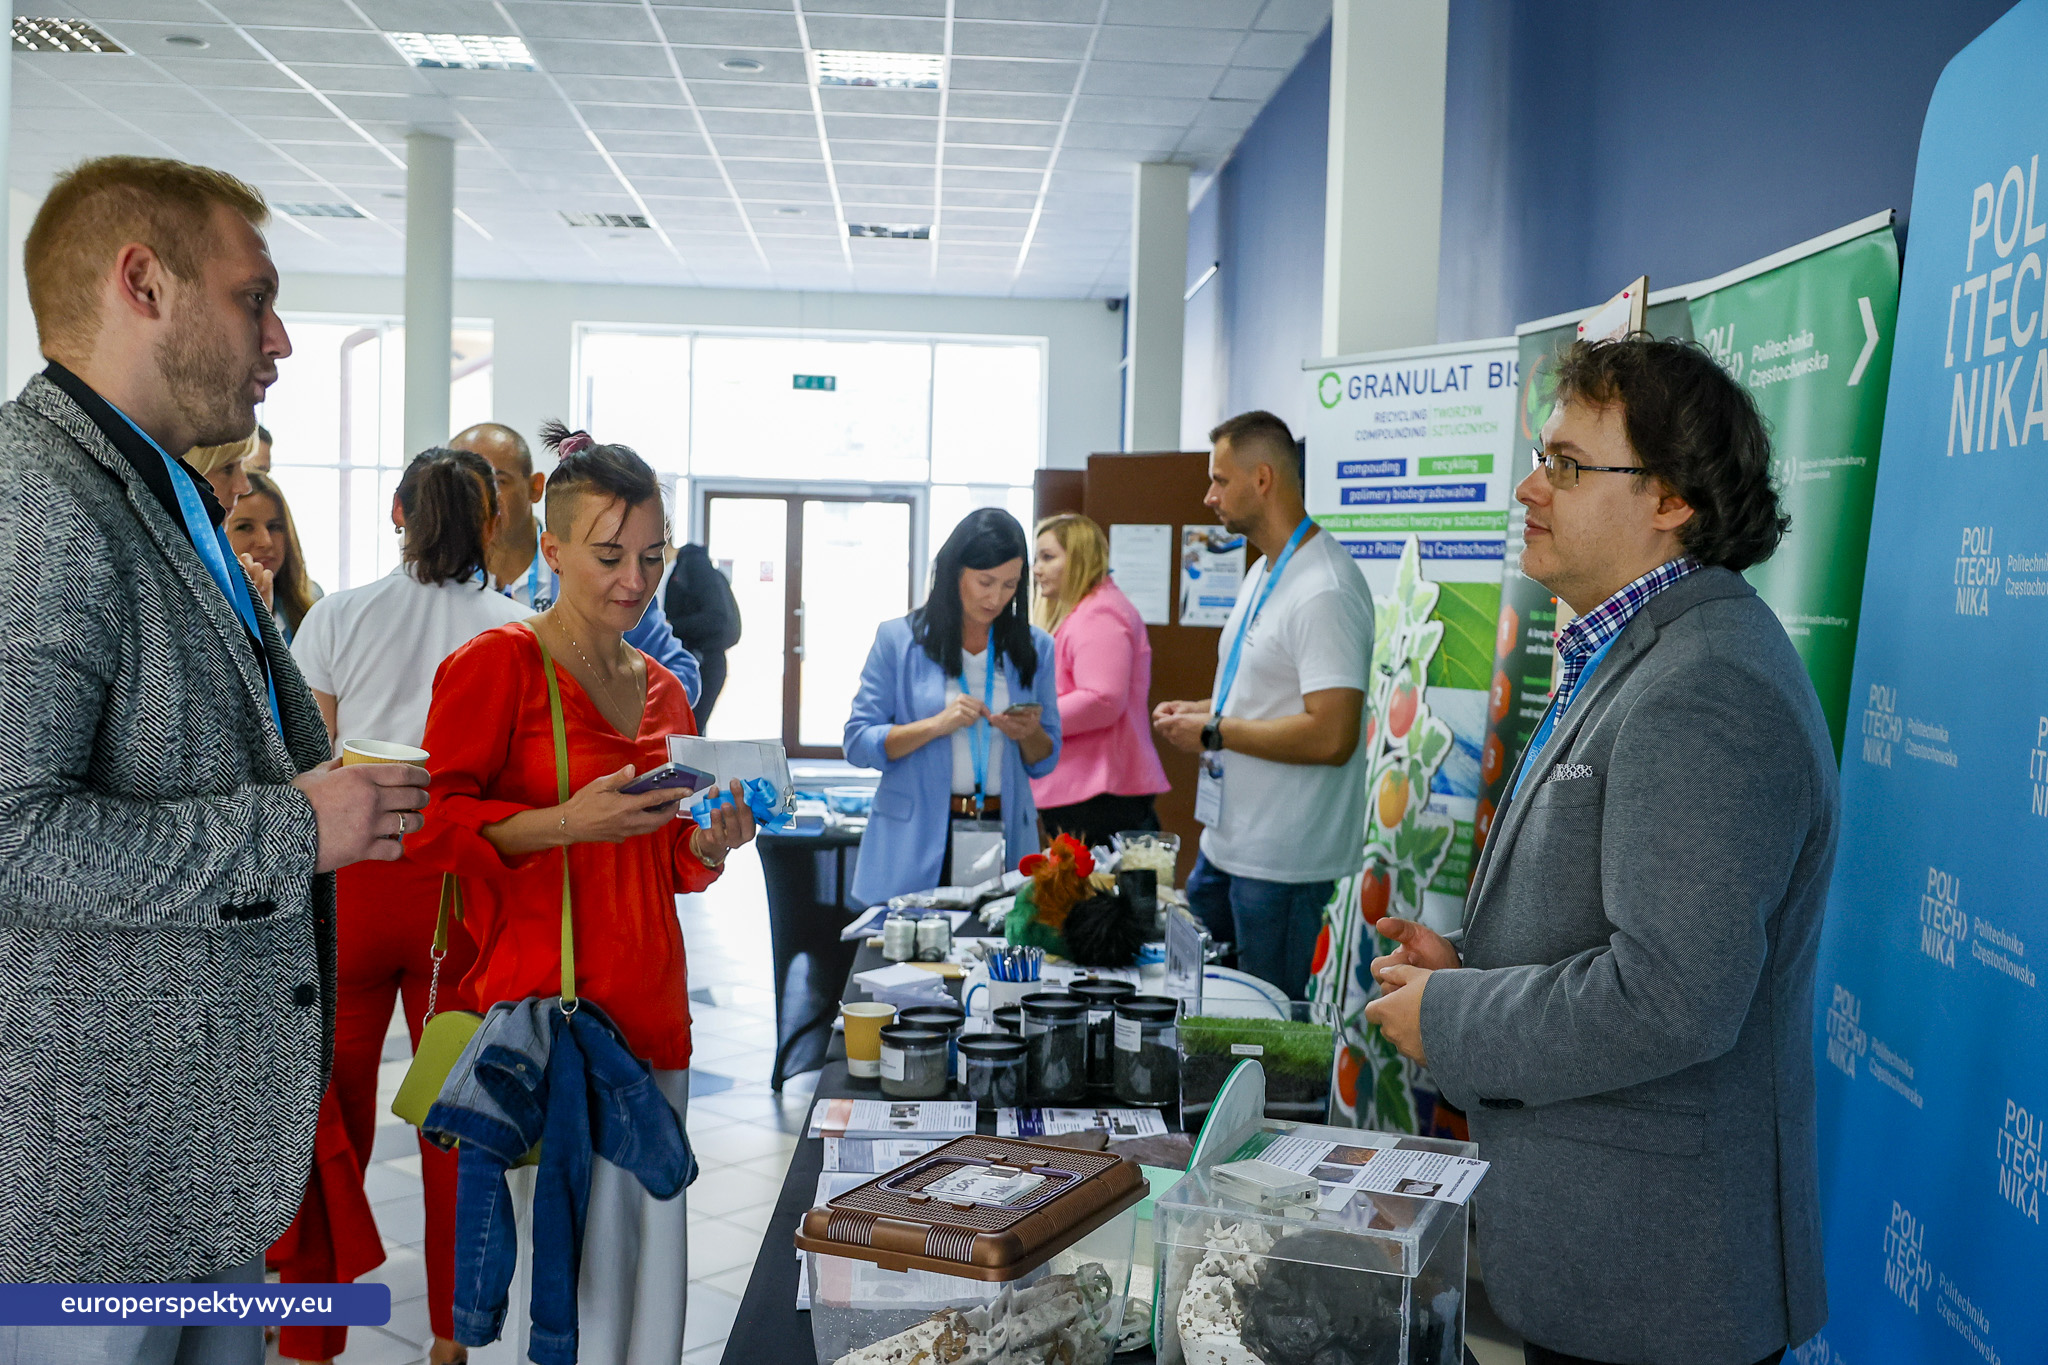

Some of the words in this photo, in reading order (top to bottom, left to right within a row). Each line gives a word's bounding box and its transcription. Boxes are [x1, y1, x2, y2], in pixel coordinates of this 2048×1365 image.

[1751, 329, 1815, 364] Politechnika
[1348, 364, 1473, 401] GRANULAT
[1749, 350, 1829, 389] Częstochowska
[1374, 407, 1427, 424] RECYCLING
[1433, 405, 1483, 418] TWORZYW
[1947, 348, 2048, 457] NIKA
[1355, 425, 1427, 441] COMPOUNDING
[1432, 421, 1498, 437] SZTUCZNYCH
[1432, 456, 1479, 473] recykling
[1349, 489, 1391, 504] polimery
[1393, 485, 1477, 502] biodegradowalne
[1411, 515, 1452, 530] tworzyw
[1961, 526, 1994, 556] POLI
[1955, 586, 1988, 616] NIKA
[1503, 620, 1509, 641] 1
[1494, 686, 1503, 706] 2
[1868, 683, 1897, 713] POLI
[1907, 716, 1949, 743] Politechnika
[1862, 736, 1892, 769] NIKA
[1927, 866, 1960, 907] POLI
[1921, 924, 1955, 969] NIKA
[1974, 916, 2024, 957] Politechnika
[1972, 939, 2036, 988] Częstochowska
[1832, 983, 1861, 1026] POLI
[1826, 1035, 1856, 1080] NIKA
[2005, 1098, 2044, 1153] POLI
[1998, 1163, 2039, 1225] NIKA
[1891, 1200, 1925, 1253] POLI
[1884, 1257, 1919, 1315] NIKA
[1939, 1271, 1990, 1335] Politechnika
[1936, 1293, 2001, 1365] Częstochowska
